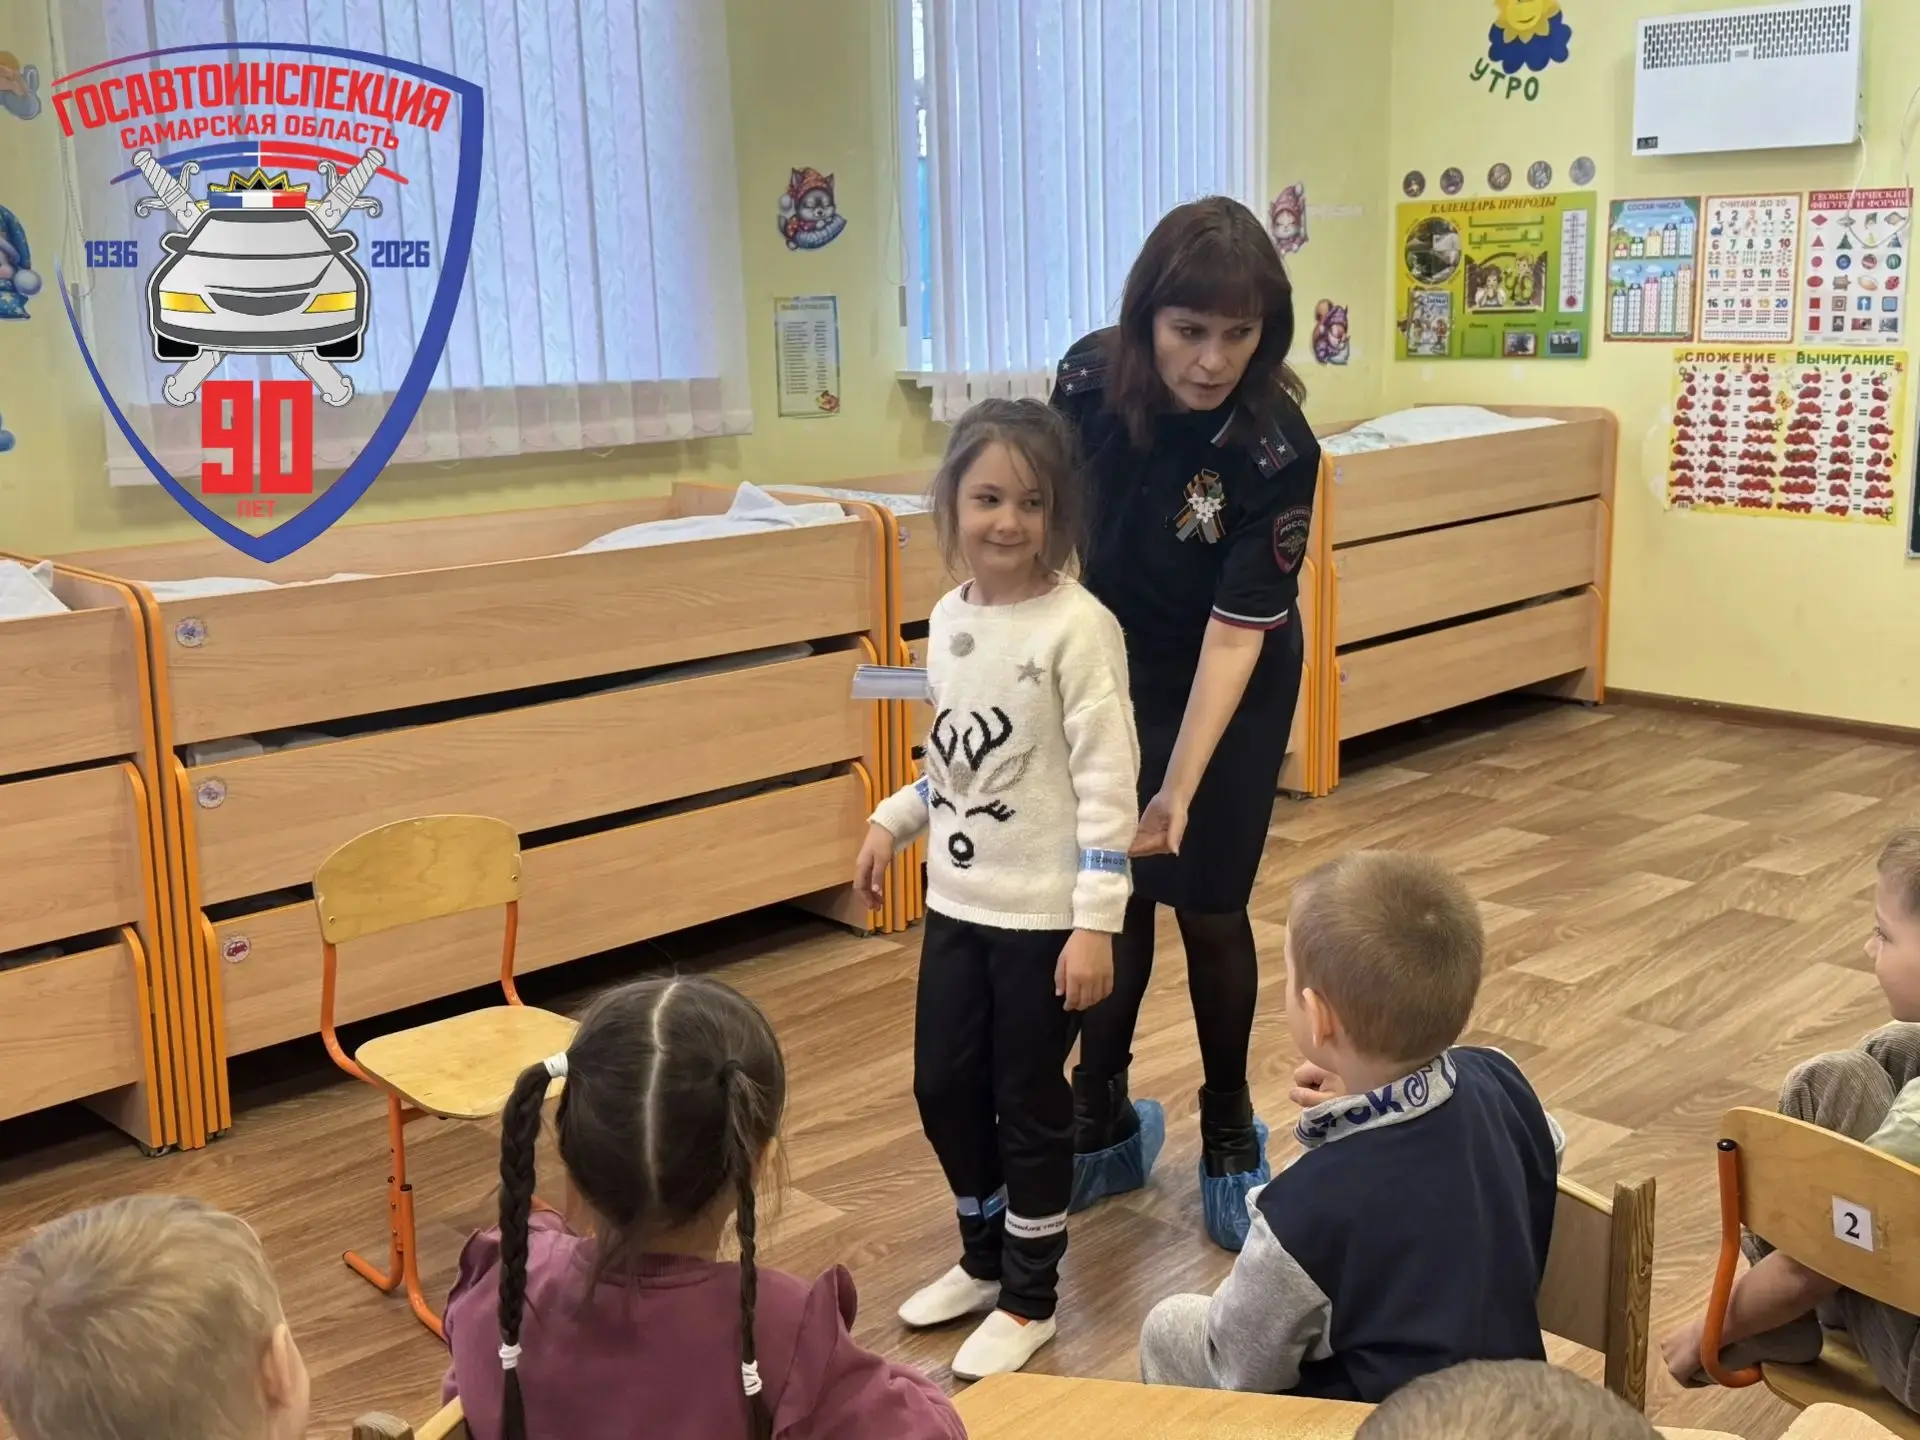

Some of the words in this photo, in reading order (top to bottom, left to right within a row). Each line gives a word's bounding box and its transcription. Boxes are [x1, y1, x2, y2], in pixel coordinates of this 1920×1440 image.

[1469, 57, 1539, 101] УТРО
[1430, 199, 1496, 214] КАЛЕНДАРЬ
[1499, 196, 1557, 210] ПРИРОДЫ
[1719, 200, 1757, 209] СЧИТАЕМ
[1759, 200, 1774, 208] ДО
[1715, 210, 1721, 221] 1
[1731, 210, 1738, 221] 2
[1765, 209, 1772, 220] 4
[1784, 208, 1791, 220] 5
[1712, 239, 1719, 250] 6
[1729, 239, 1737, 249] 7
[1747, 238, 1754, 249] 8
[1763, 238, 1771, 249] 9
[1779, 238, 1791, 248] 10
[1708, 269, 1720, 279] 11
[1725, 269, 1736, 279] 12
[1742, 268, 1754, 278] 13
[1760, 268, 1771, 278] 14
[1777, 268, 1789, 278] 15
[1707, 298, 1718, 308] 16
[1724, 298, 1735, 308] 17
[1741, 298, 1752, 308] 18
[1775, 298, 1788, 308] 20
[1684, 352, 1776, 364] СЛОЖЕНИЕ
[1796, 351, 1895, 366] ВЫЧИТАНИЕ
[1843, 1211, 1860, 1240] 2
